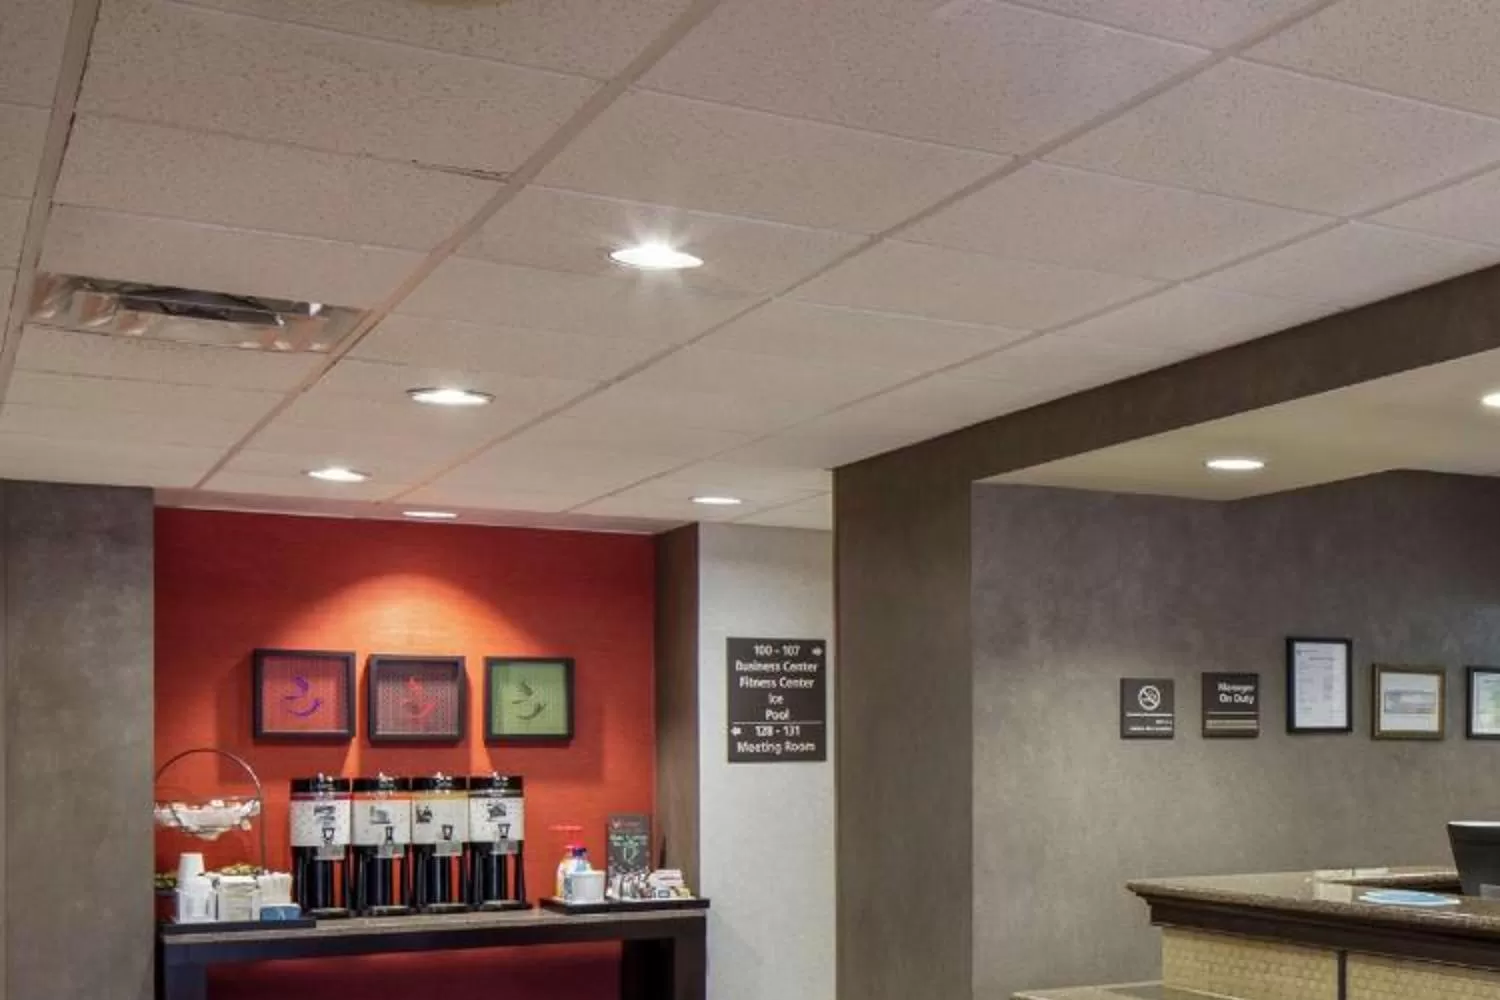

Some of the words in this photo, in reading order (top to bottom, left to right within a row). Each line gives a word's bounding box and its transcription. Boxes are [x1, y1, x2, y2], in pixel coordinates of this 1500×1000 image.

[735, 660, 780, 672] Business
[783, 661, 818, 672] Center
[739, 676, 777, 688] Fitness
[780, 676, 815, 688] Center
[1219, 693, 1233, 703] On
[1234, 693, 1255, 704] Duty
[765, 708, 790, 720] Pool
[737, 741, 782, 755] Meeting
[784, 741, 816, 752] Room
